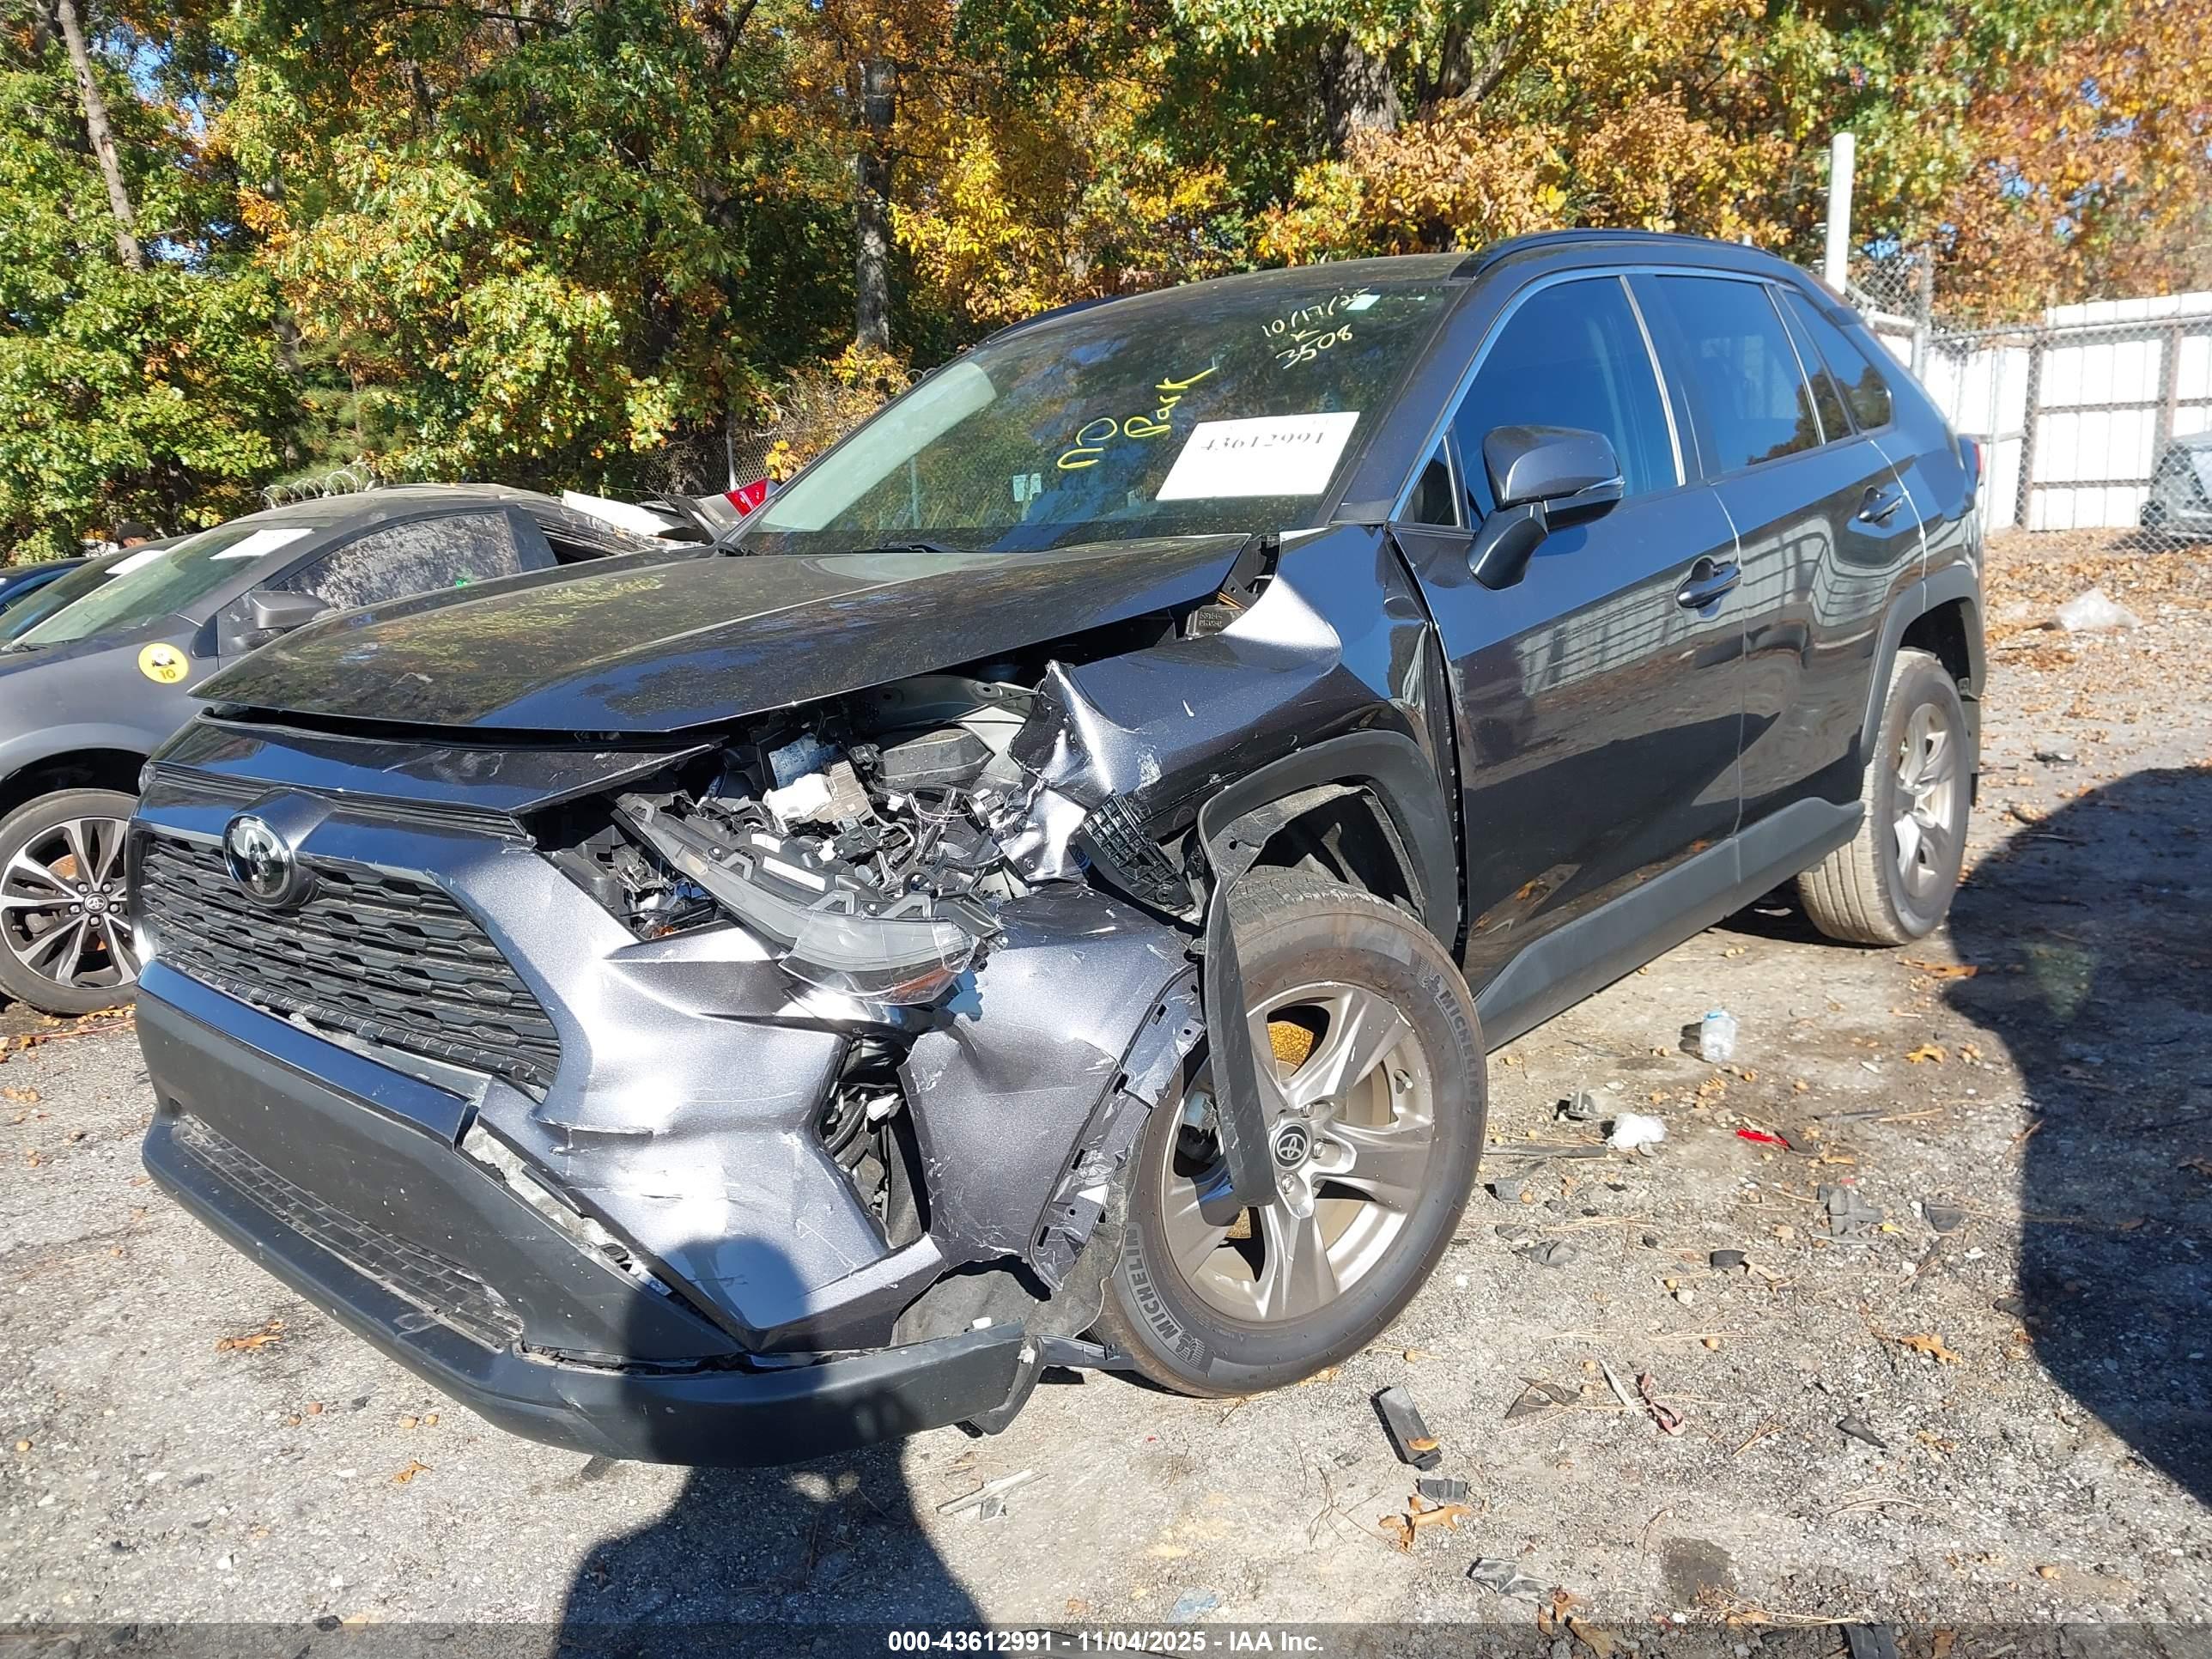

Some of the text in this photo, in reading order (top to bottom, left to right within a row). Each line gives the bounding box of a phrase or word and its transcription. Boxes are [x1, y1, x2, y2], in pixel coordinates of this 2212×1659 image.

[1275, 323, 1353, 369] 3508
[159, 669, 176, 680] 10
[1438, 989, 1480, 1097] MICHELIN
[1126, 1229, 1179, 1340] MICHELIN
